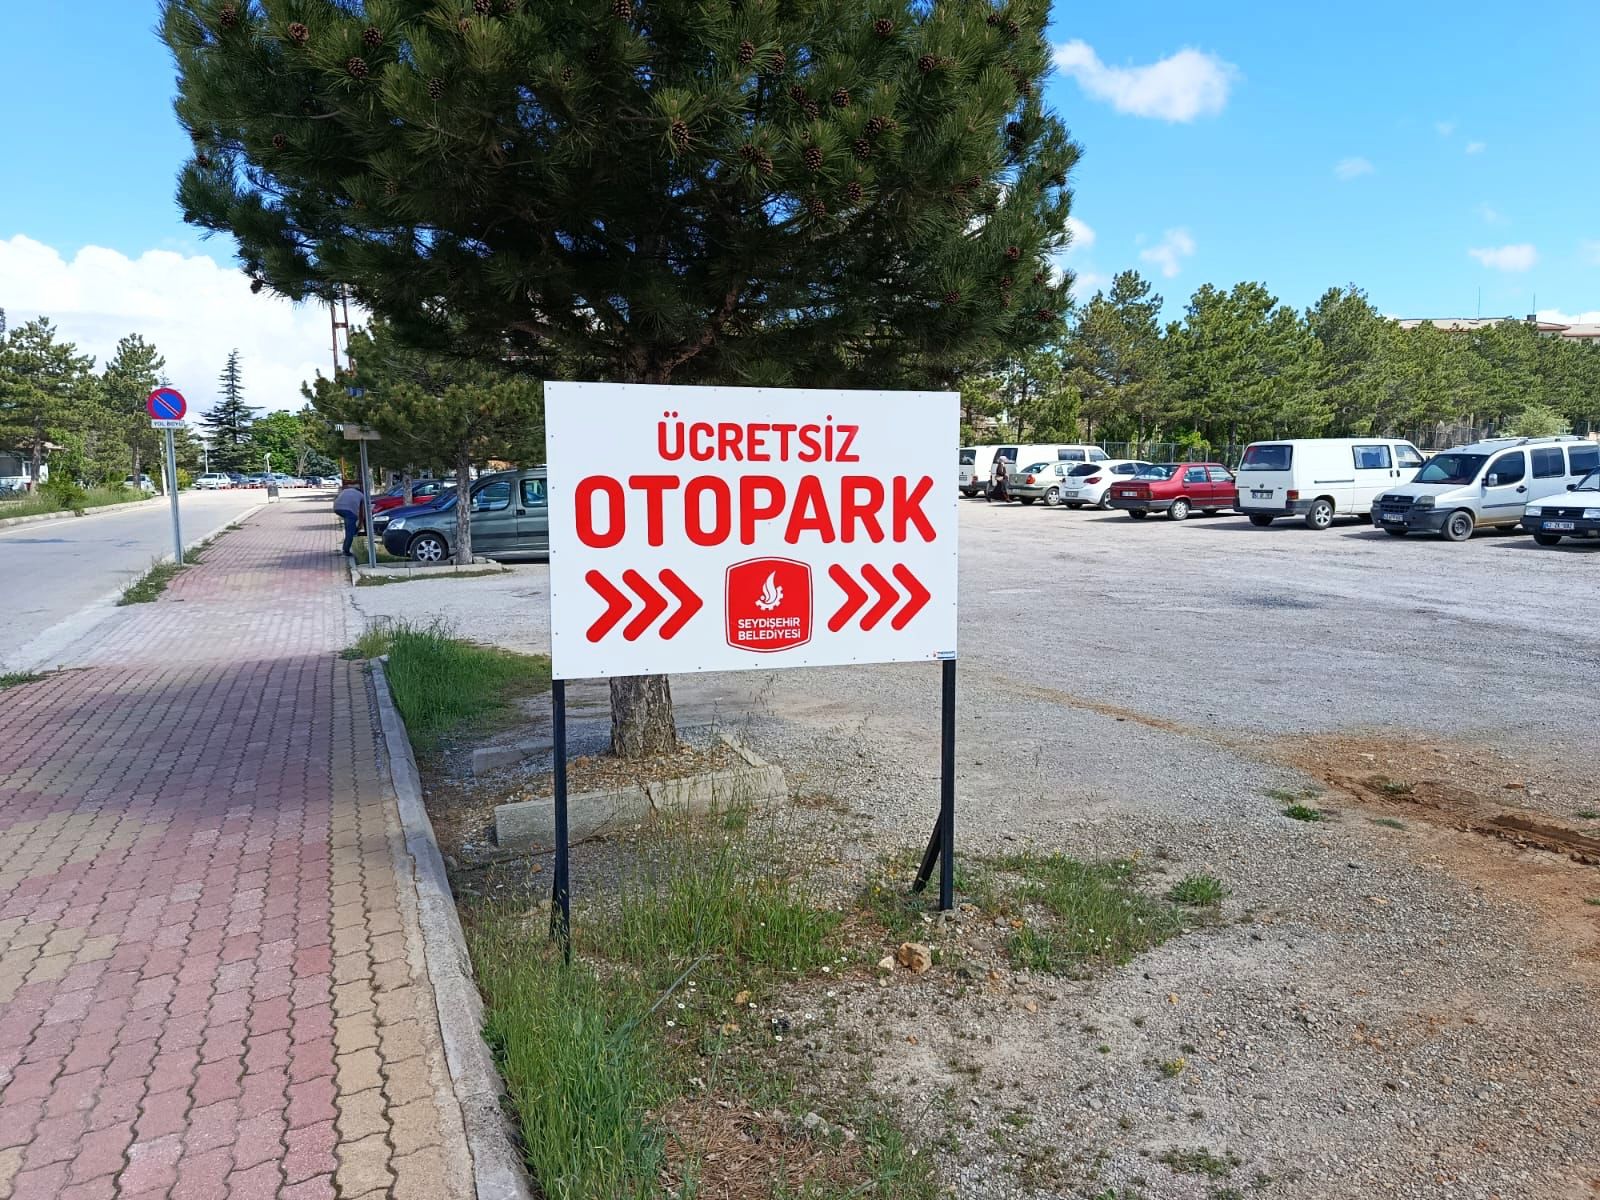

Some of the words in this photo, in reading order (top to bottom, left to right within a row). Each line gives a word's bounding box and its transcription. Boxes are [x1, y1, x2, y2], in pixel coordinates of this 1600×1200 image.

[657, 411, 860, 463] ÜCRETSİZ
[574, 474, 937, 549] OTOPARK
[737, 617, 801, 629] SEYDİŞEHİR
[737, 629, 801, 641] BELEDİYESİ
